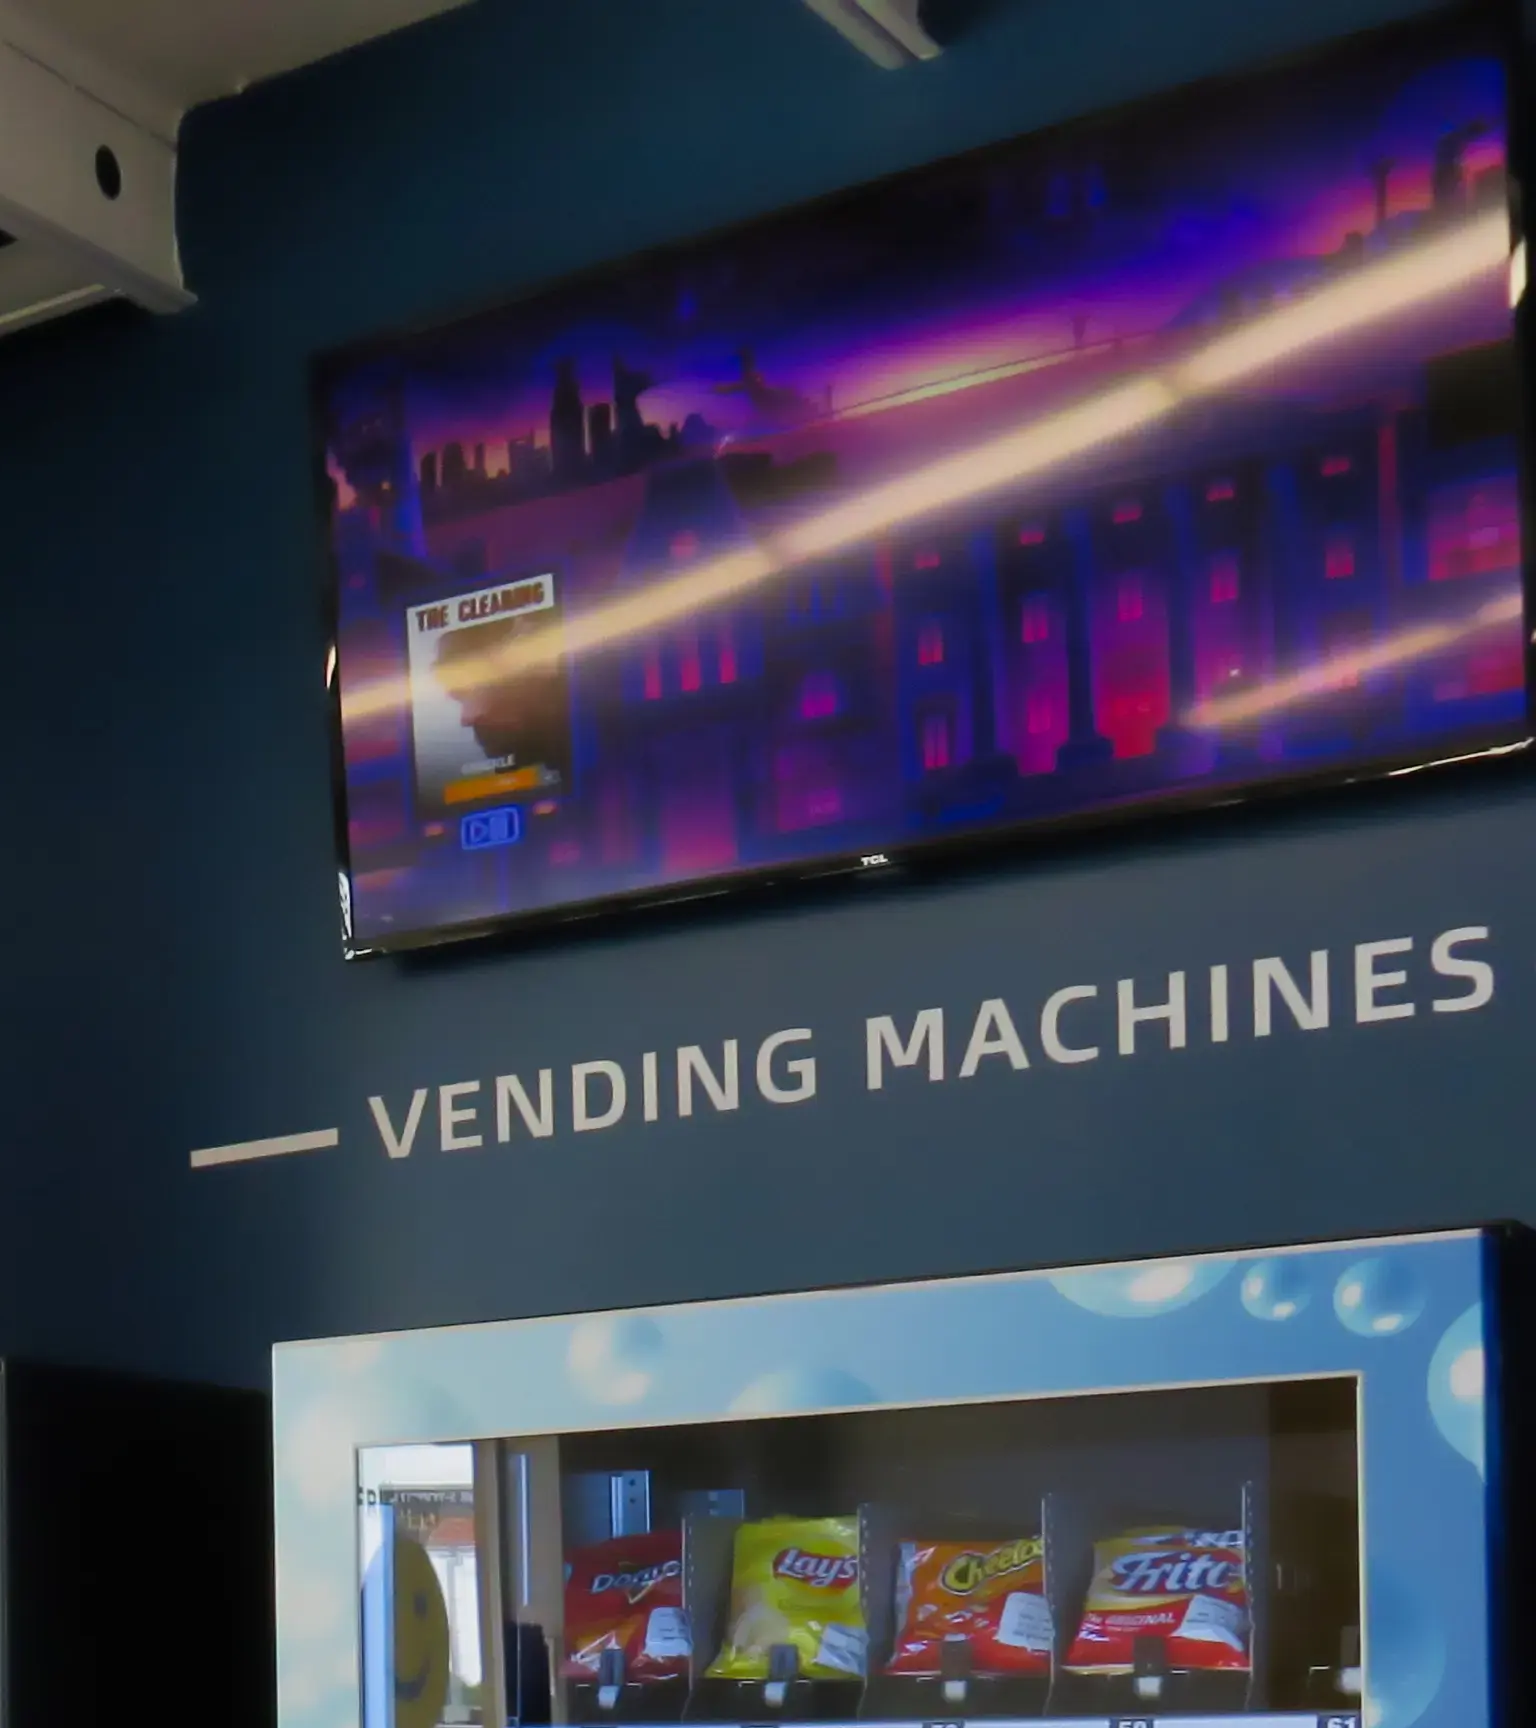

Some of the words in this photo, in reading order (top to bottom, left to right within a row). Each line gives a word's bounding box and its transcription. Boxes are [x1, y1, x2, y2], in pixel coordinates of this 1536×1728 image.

[861, 854, 888, 866] TCL
[368, 1029, 818, 1159] VENDING
[864, 925, 1495, 1090] MACHINES
[1105, 1611, 1176, 1626] ORIGINAL
